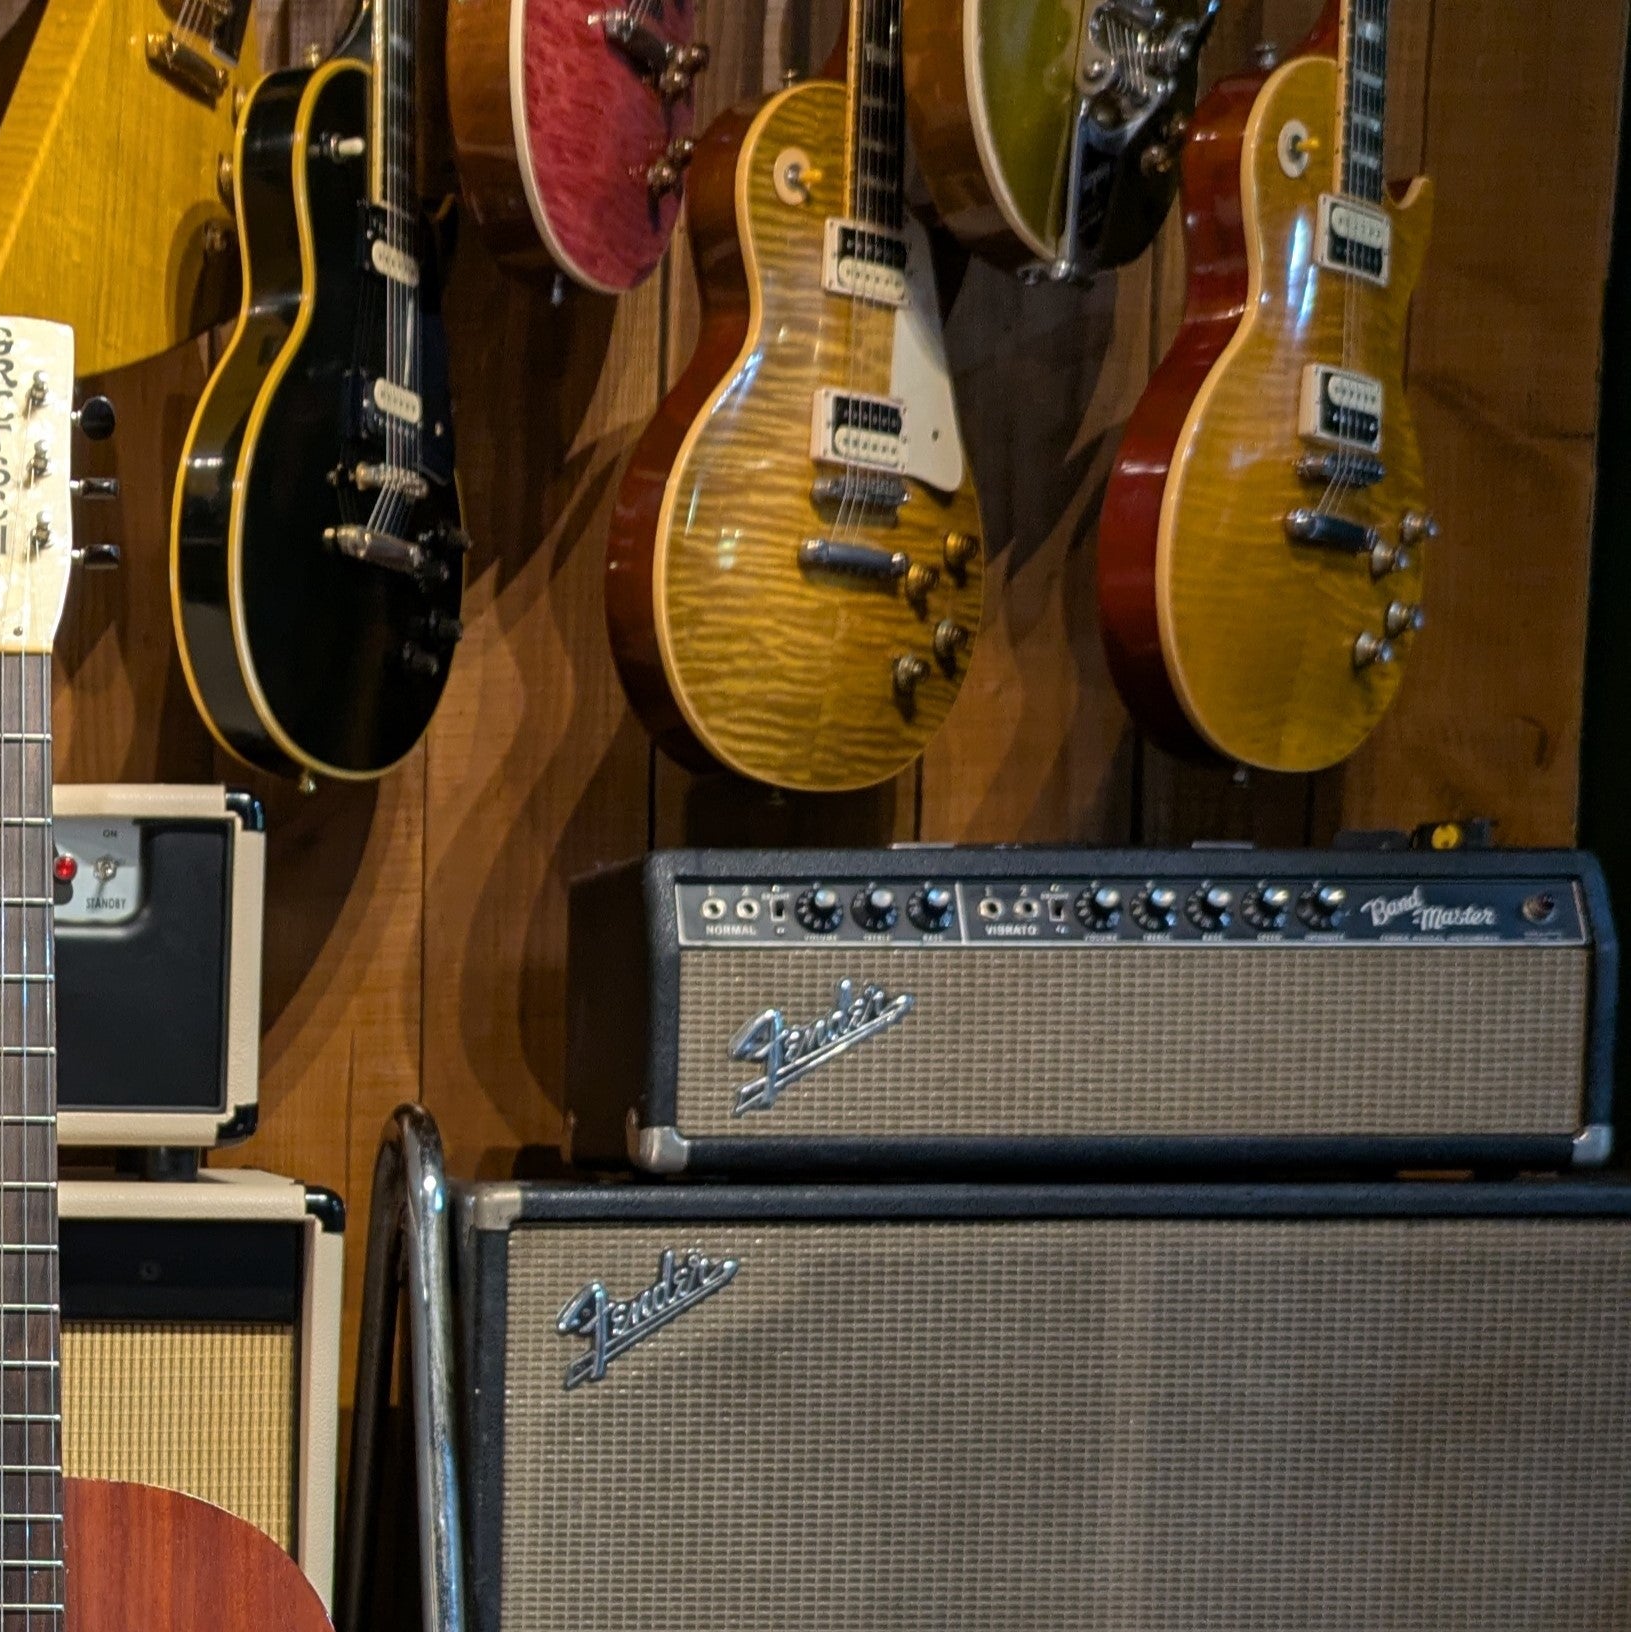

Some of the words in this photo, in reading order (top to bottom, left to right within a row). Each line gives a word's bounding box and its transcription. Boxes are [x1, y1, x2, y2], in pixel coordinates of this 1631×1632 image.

[103, 829, 117, 838] ON
[86, 898, 126, 910] STANDBY
[1360, 885, 1422, 926] Band
[705, 925, 756, 935] NORMAL
[985, 925, 1038, 936] VIBRATO
[729, 976, 915, 1117] Fender
[556, 1246, 739, 1389] Fender
